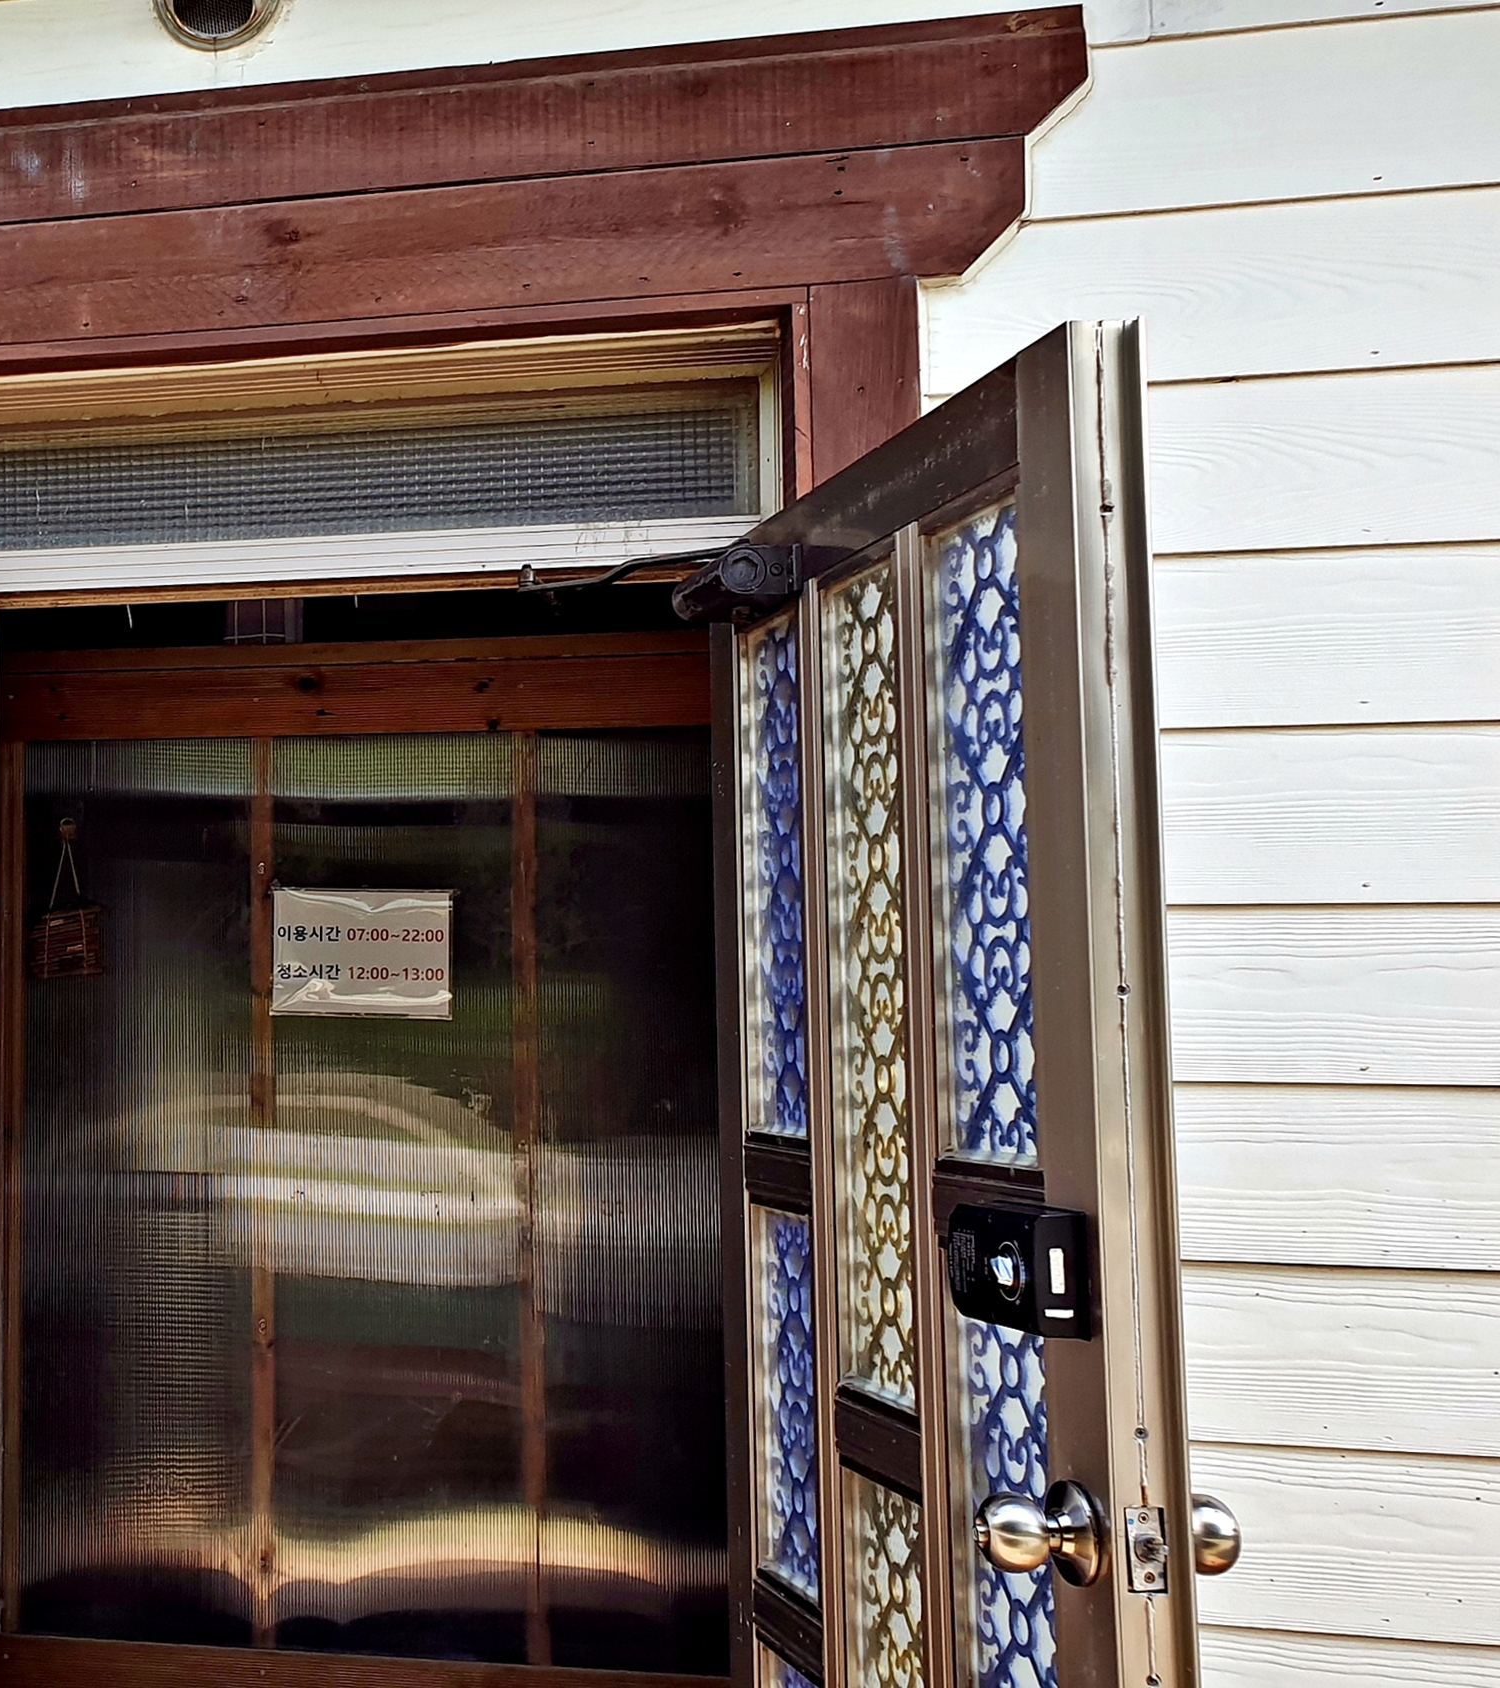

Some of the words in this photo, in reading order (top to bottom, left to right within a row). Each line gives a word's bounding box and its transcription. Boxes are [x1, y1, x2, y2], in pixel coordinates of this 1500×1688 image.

[277, 925, 341, 942] 이용시간
[347, 928, 444, 942] 07:00~22:00
[277, 963, 341, 980] 청소시간
[347, 966, 444, 981] 12:00~13:00
